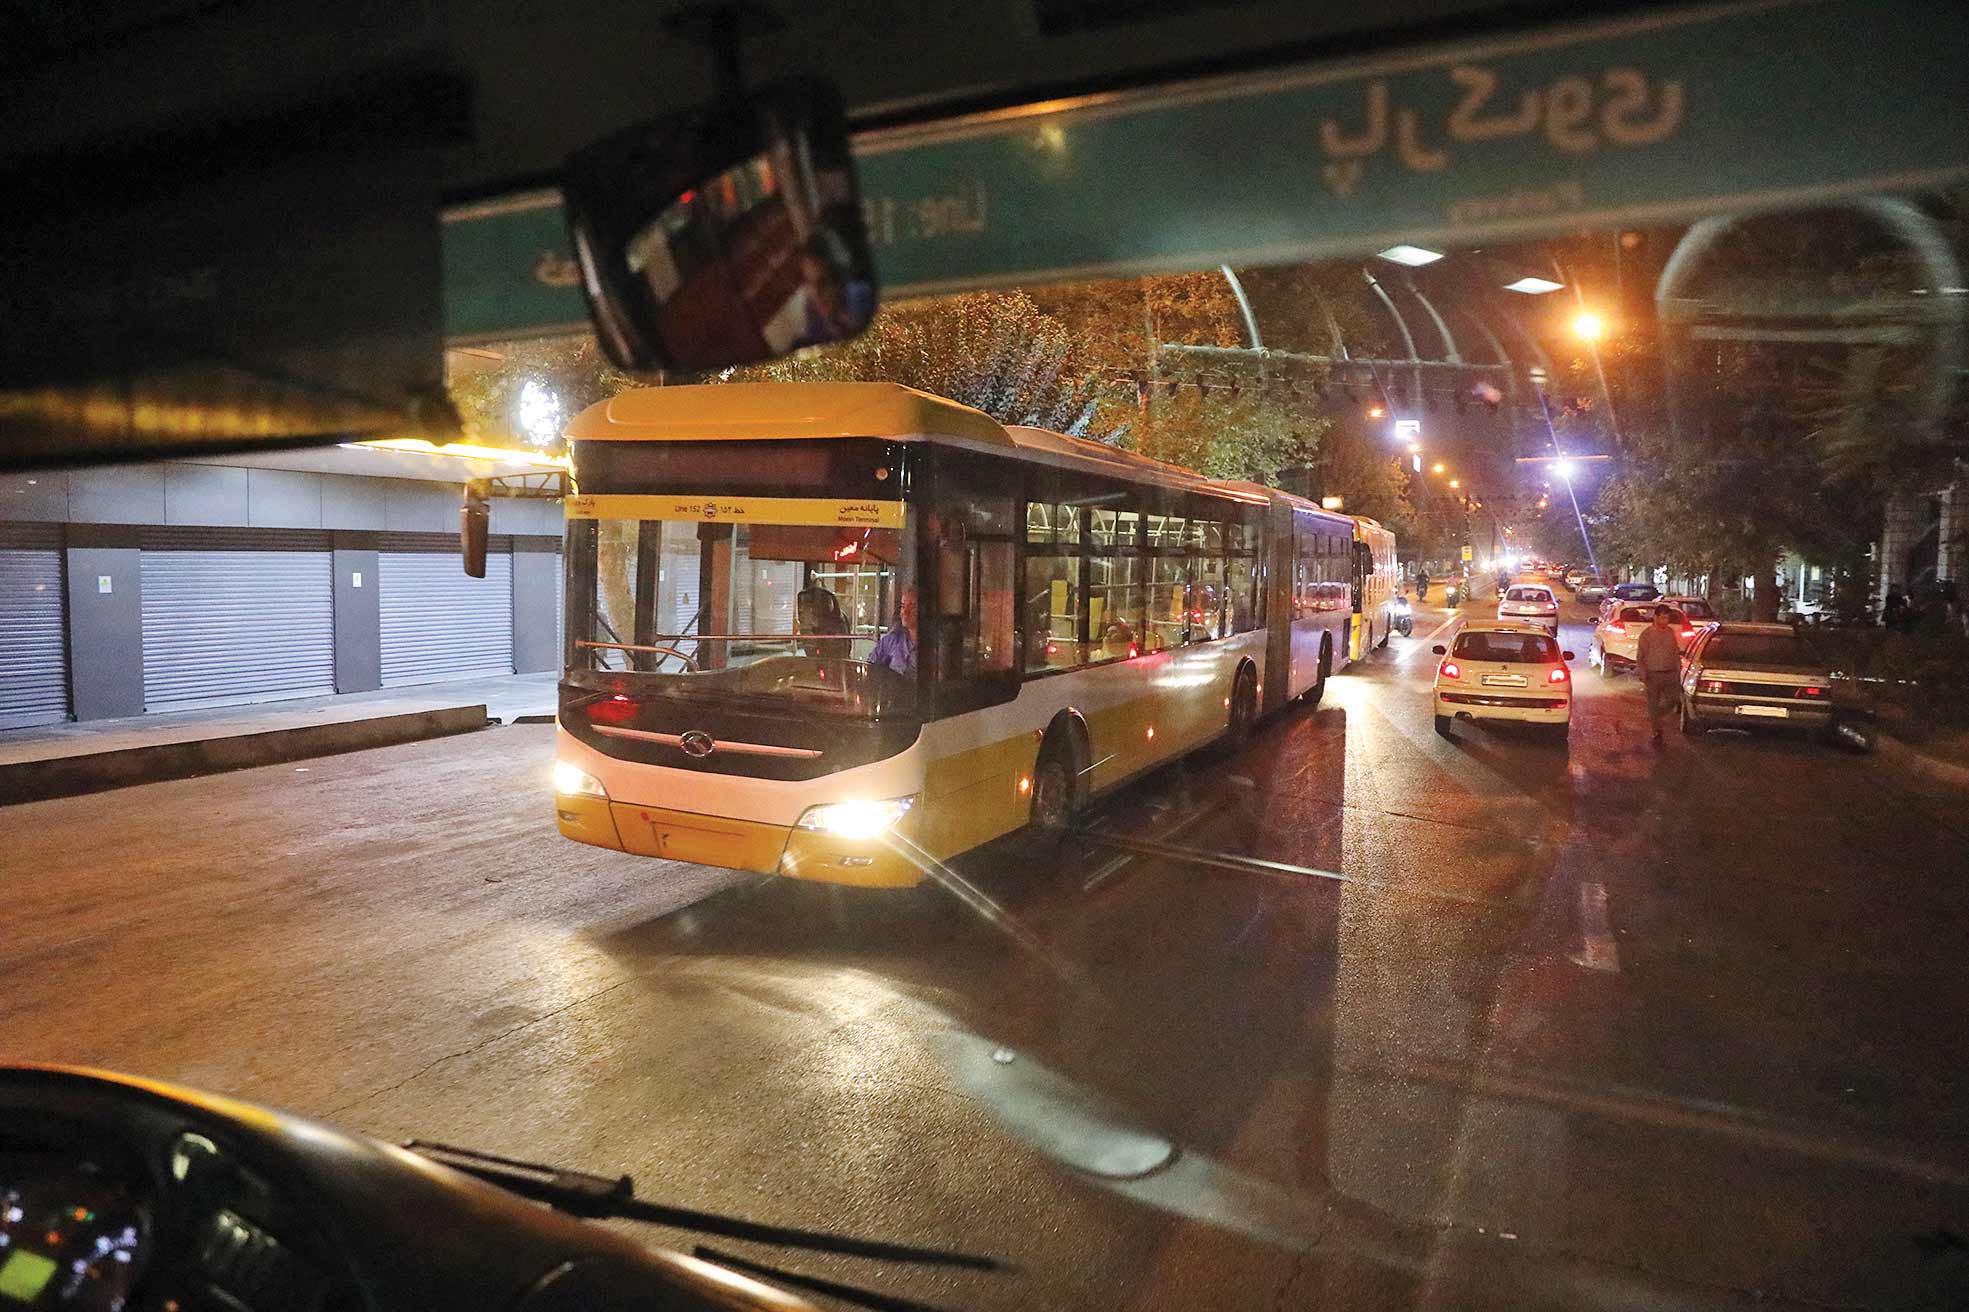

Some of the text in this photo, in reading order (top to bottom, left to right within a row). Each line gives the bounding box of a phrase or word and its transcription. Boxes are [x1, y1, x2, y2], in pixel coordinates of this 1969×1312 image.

[674, 504, 701, 513] Line 152
[733, 505, 745, 514] خط
[839, 503, 879, 515] پایانه معین
